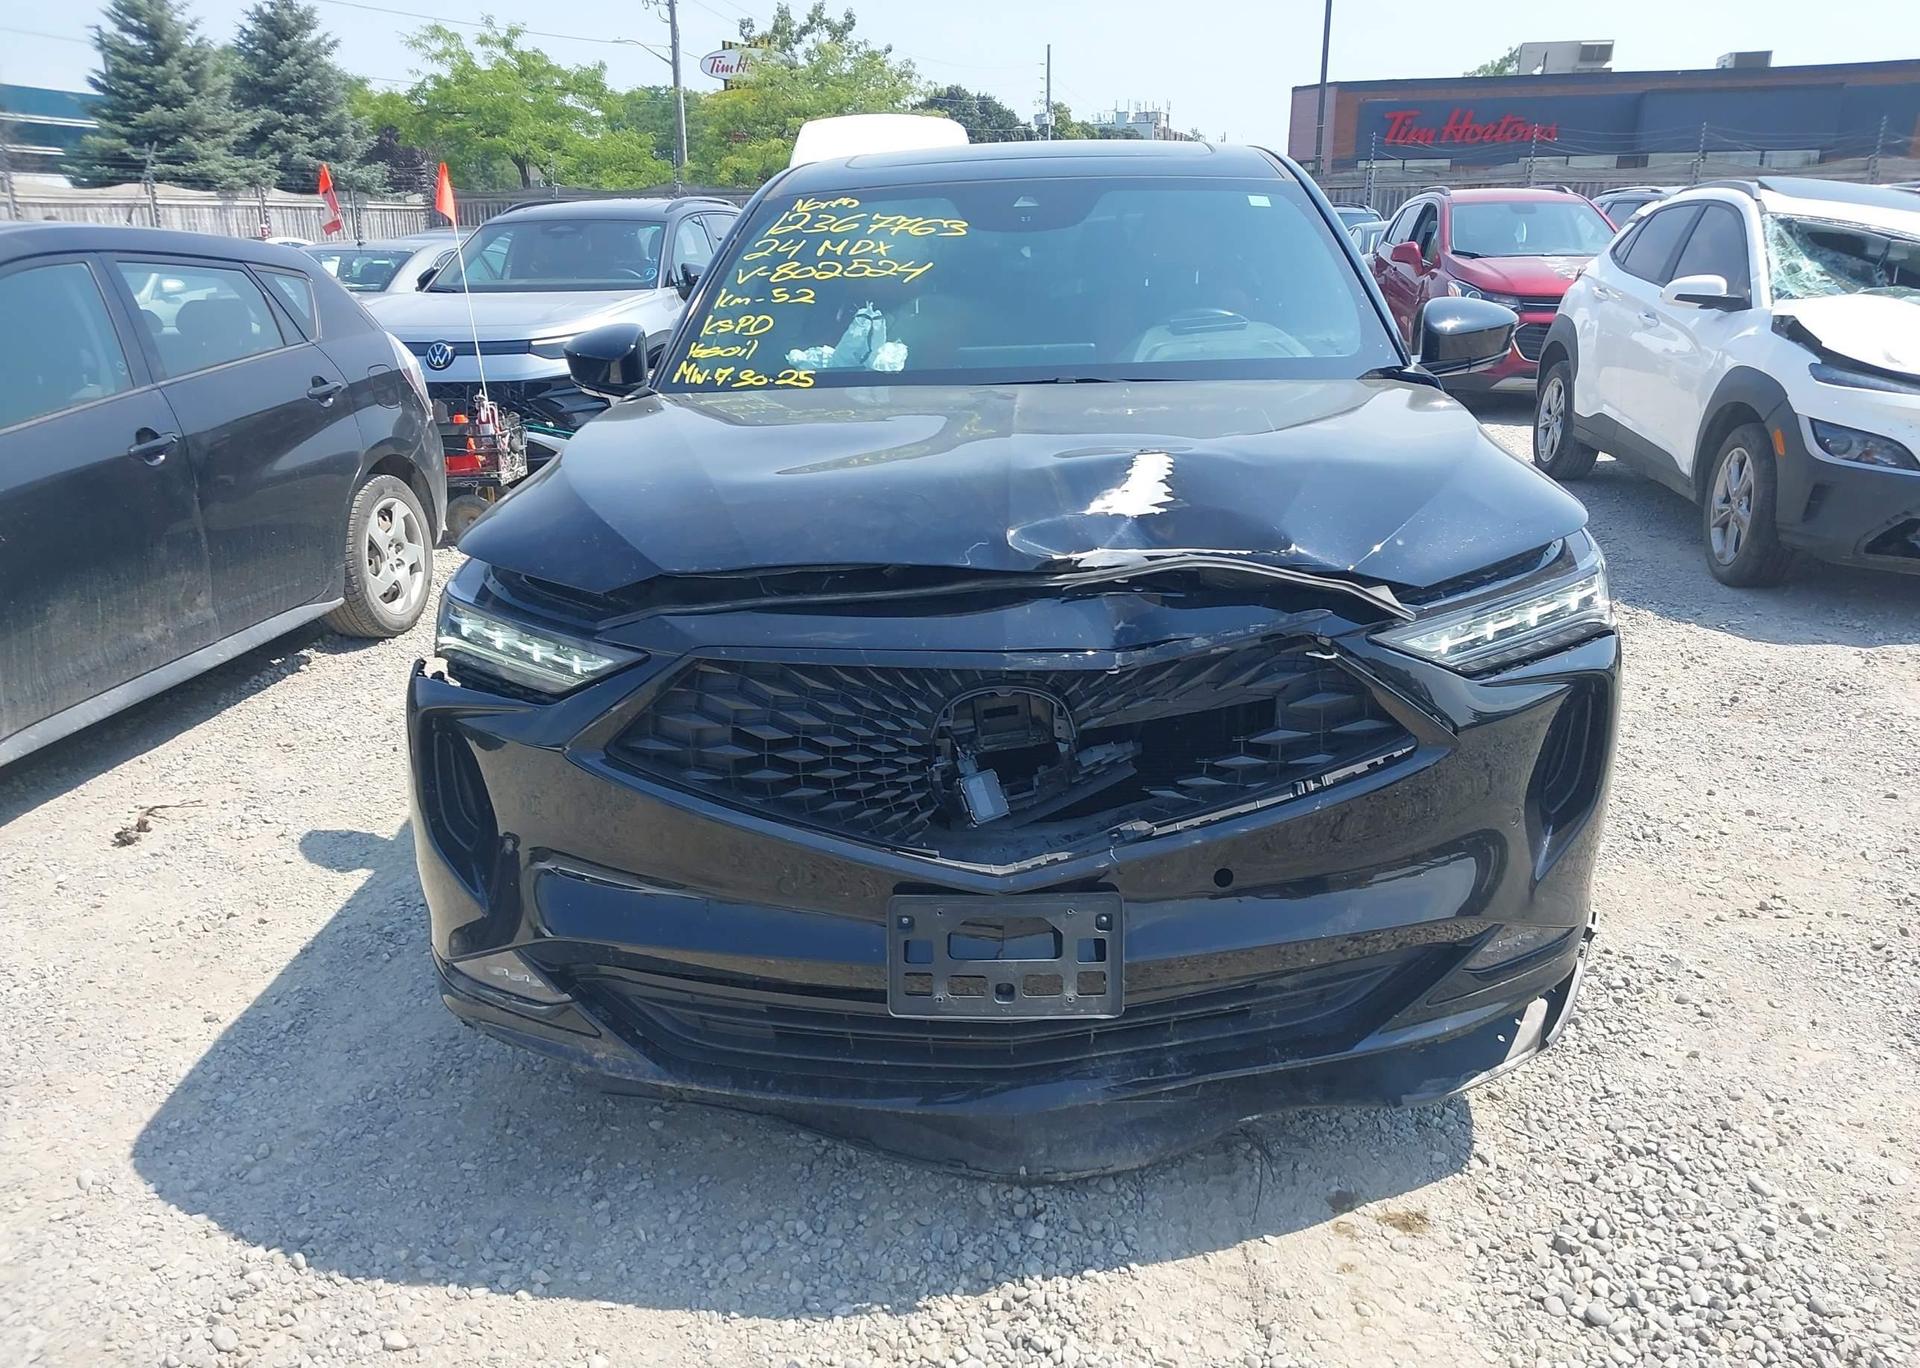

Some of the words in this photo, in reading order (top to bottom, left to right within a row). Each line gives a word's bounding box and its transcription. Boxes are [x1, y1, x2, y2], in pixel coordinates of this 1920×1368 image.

[707, 55, 734, 74] Tim
[1384, 110, 1436, 145] Tim
[1440, 107, 1559, 145] Hortons
[743, 238, 807, 261] 24
[816, 239, 896, 258] MDX
